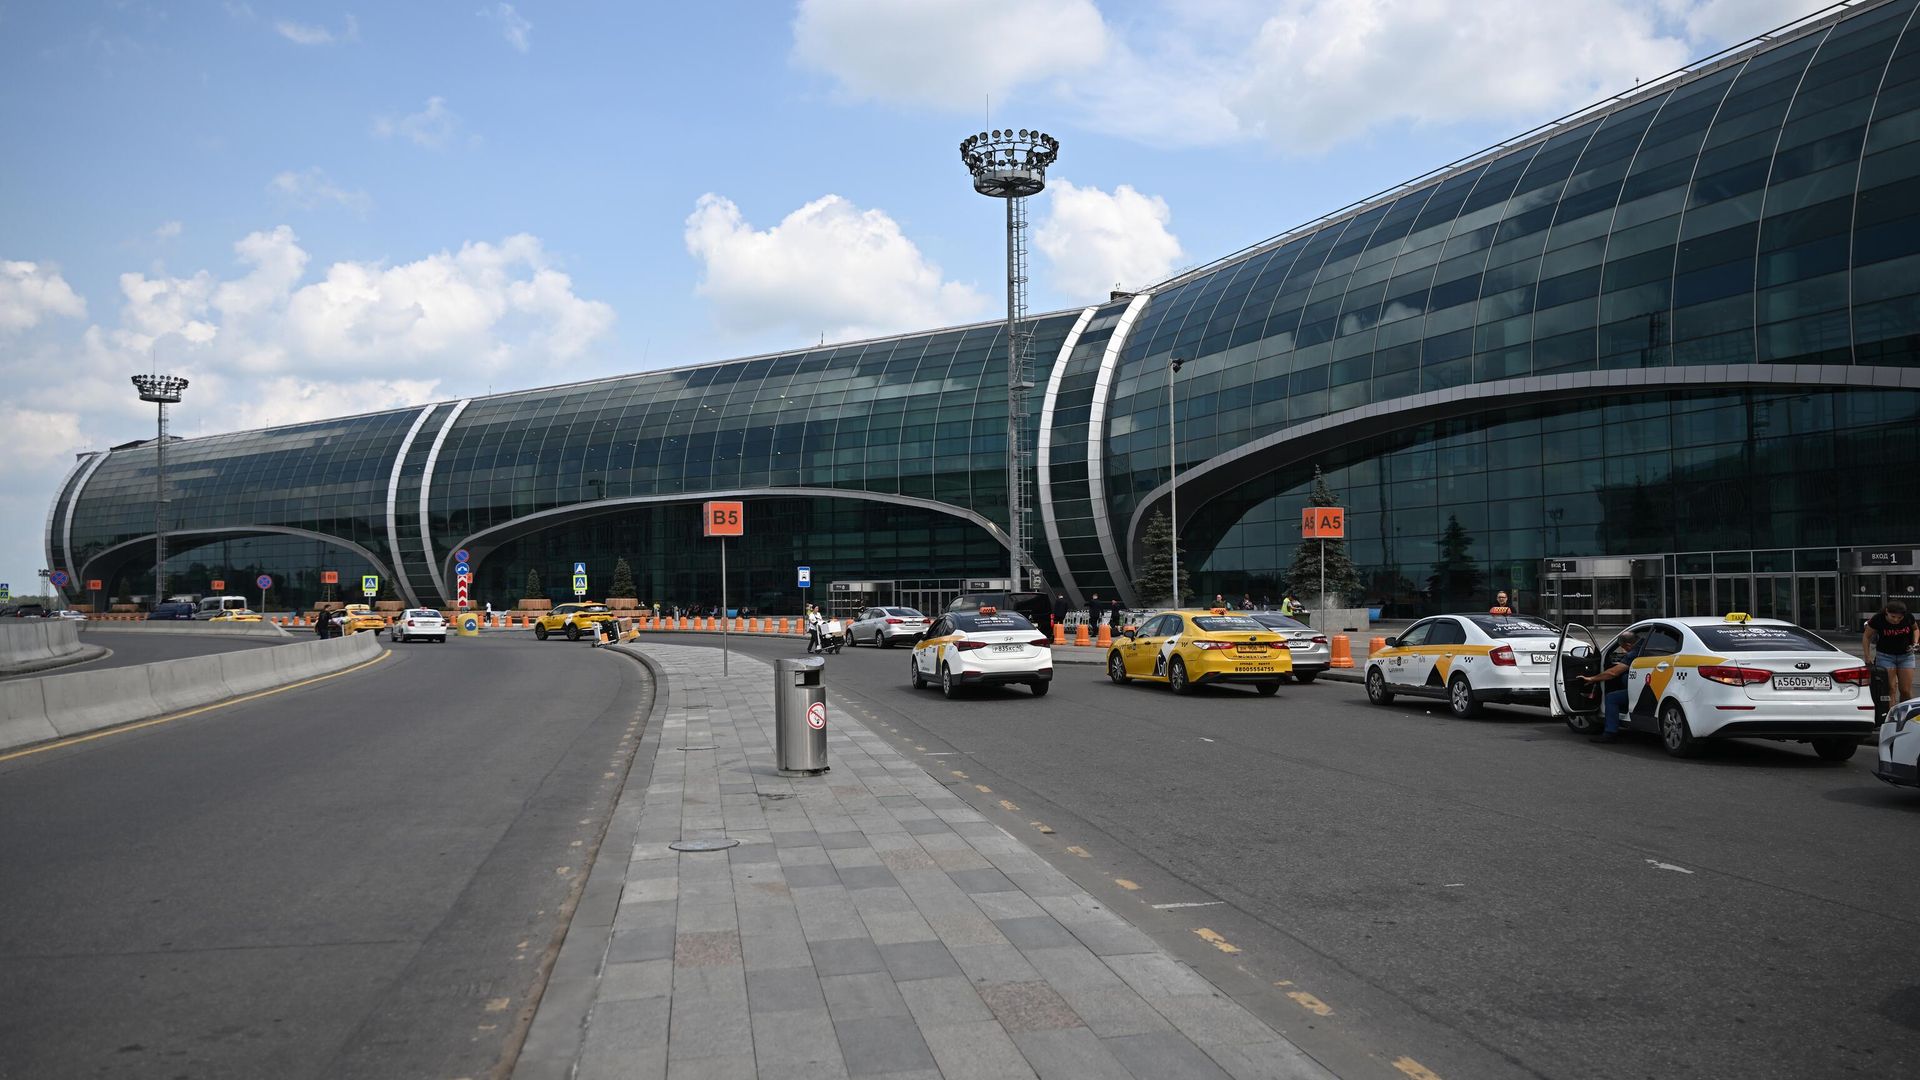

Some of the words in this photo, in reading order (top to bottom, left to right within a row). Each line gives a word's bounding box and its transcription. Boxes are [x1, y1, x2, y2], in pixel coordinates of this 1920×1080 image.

[713, 510, 738, 525] B5
[1304, 516, 1315, 530] A5
[1320, 515, 1341, 529] A5
[1890, 553, 1897, 564] 1
[1562, 562, 1567, 572] 1
